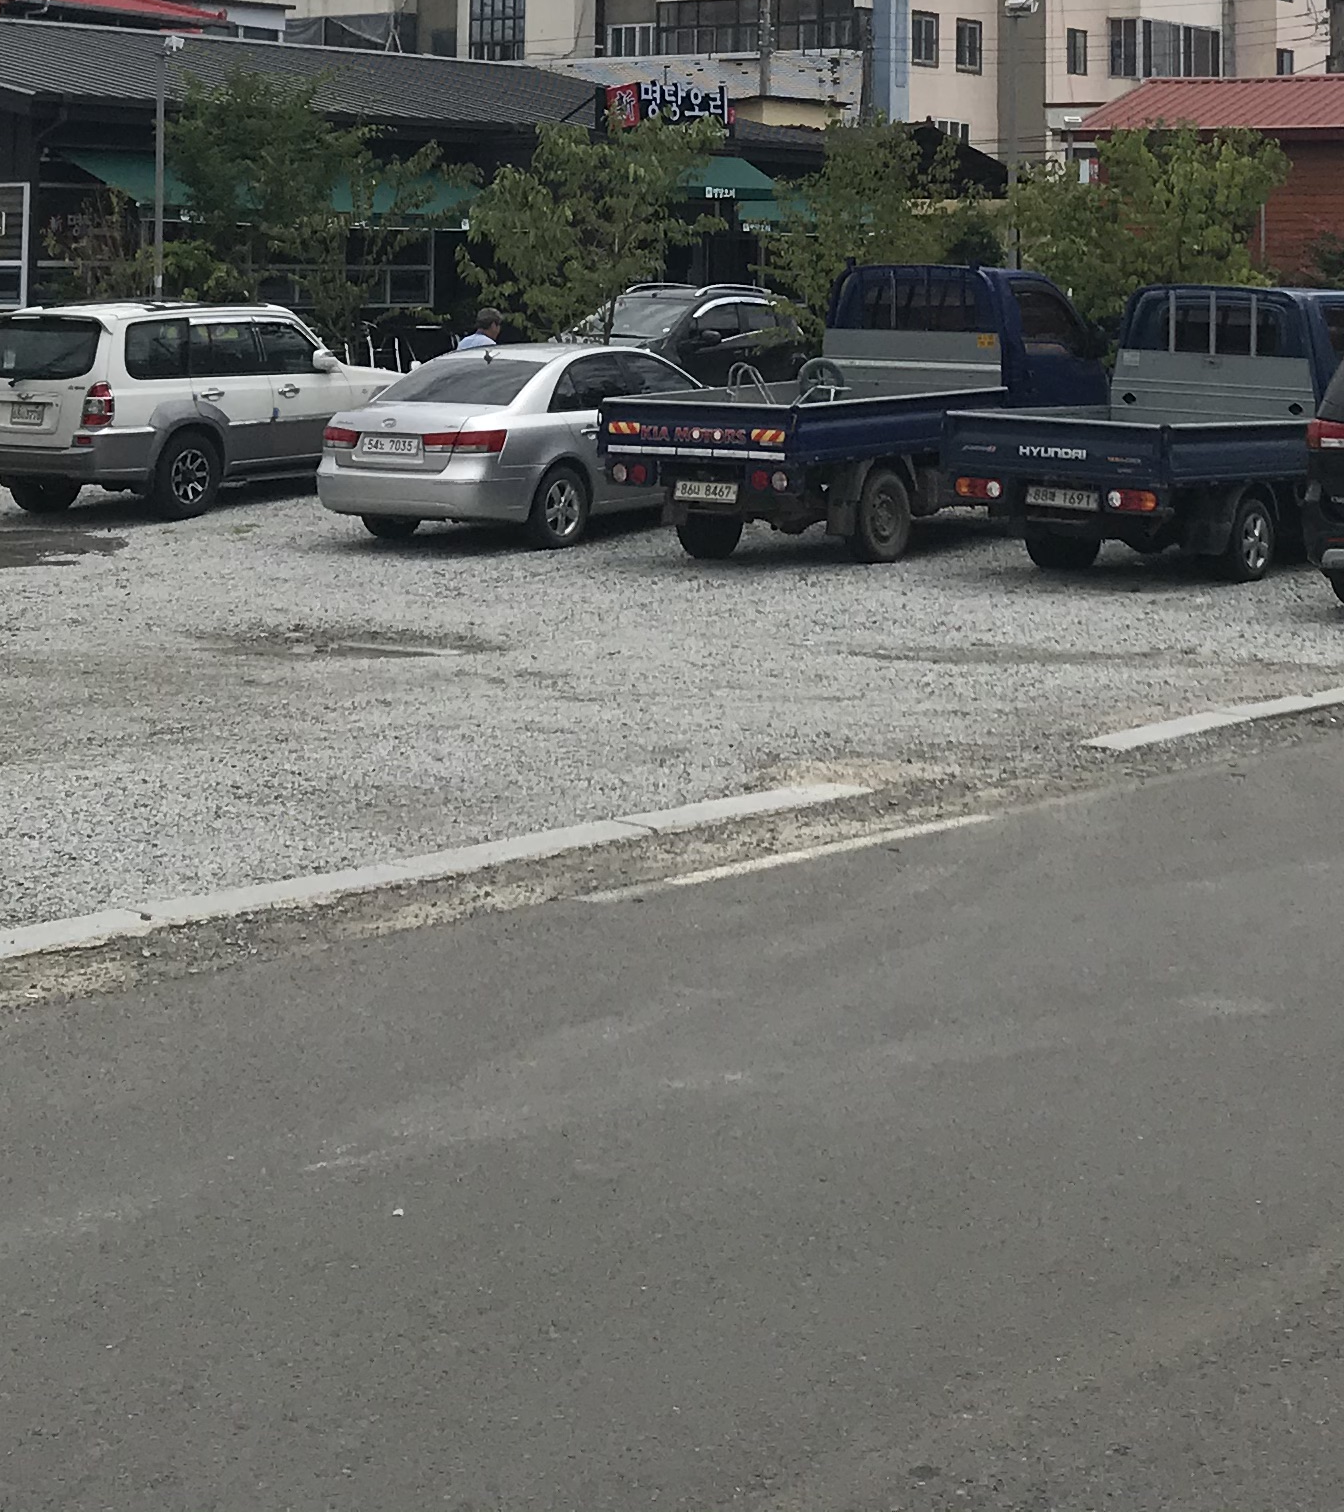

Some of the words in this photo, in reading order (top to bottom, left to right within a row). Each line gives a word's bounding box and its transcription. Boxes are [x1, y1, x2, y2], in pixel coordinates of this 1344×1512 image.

[641, 425, 670, 441] KIA
[674, 427, 747, 444] MOTORS
[1019, 445, 1087, 460] HYUNDAI
